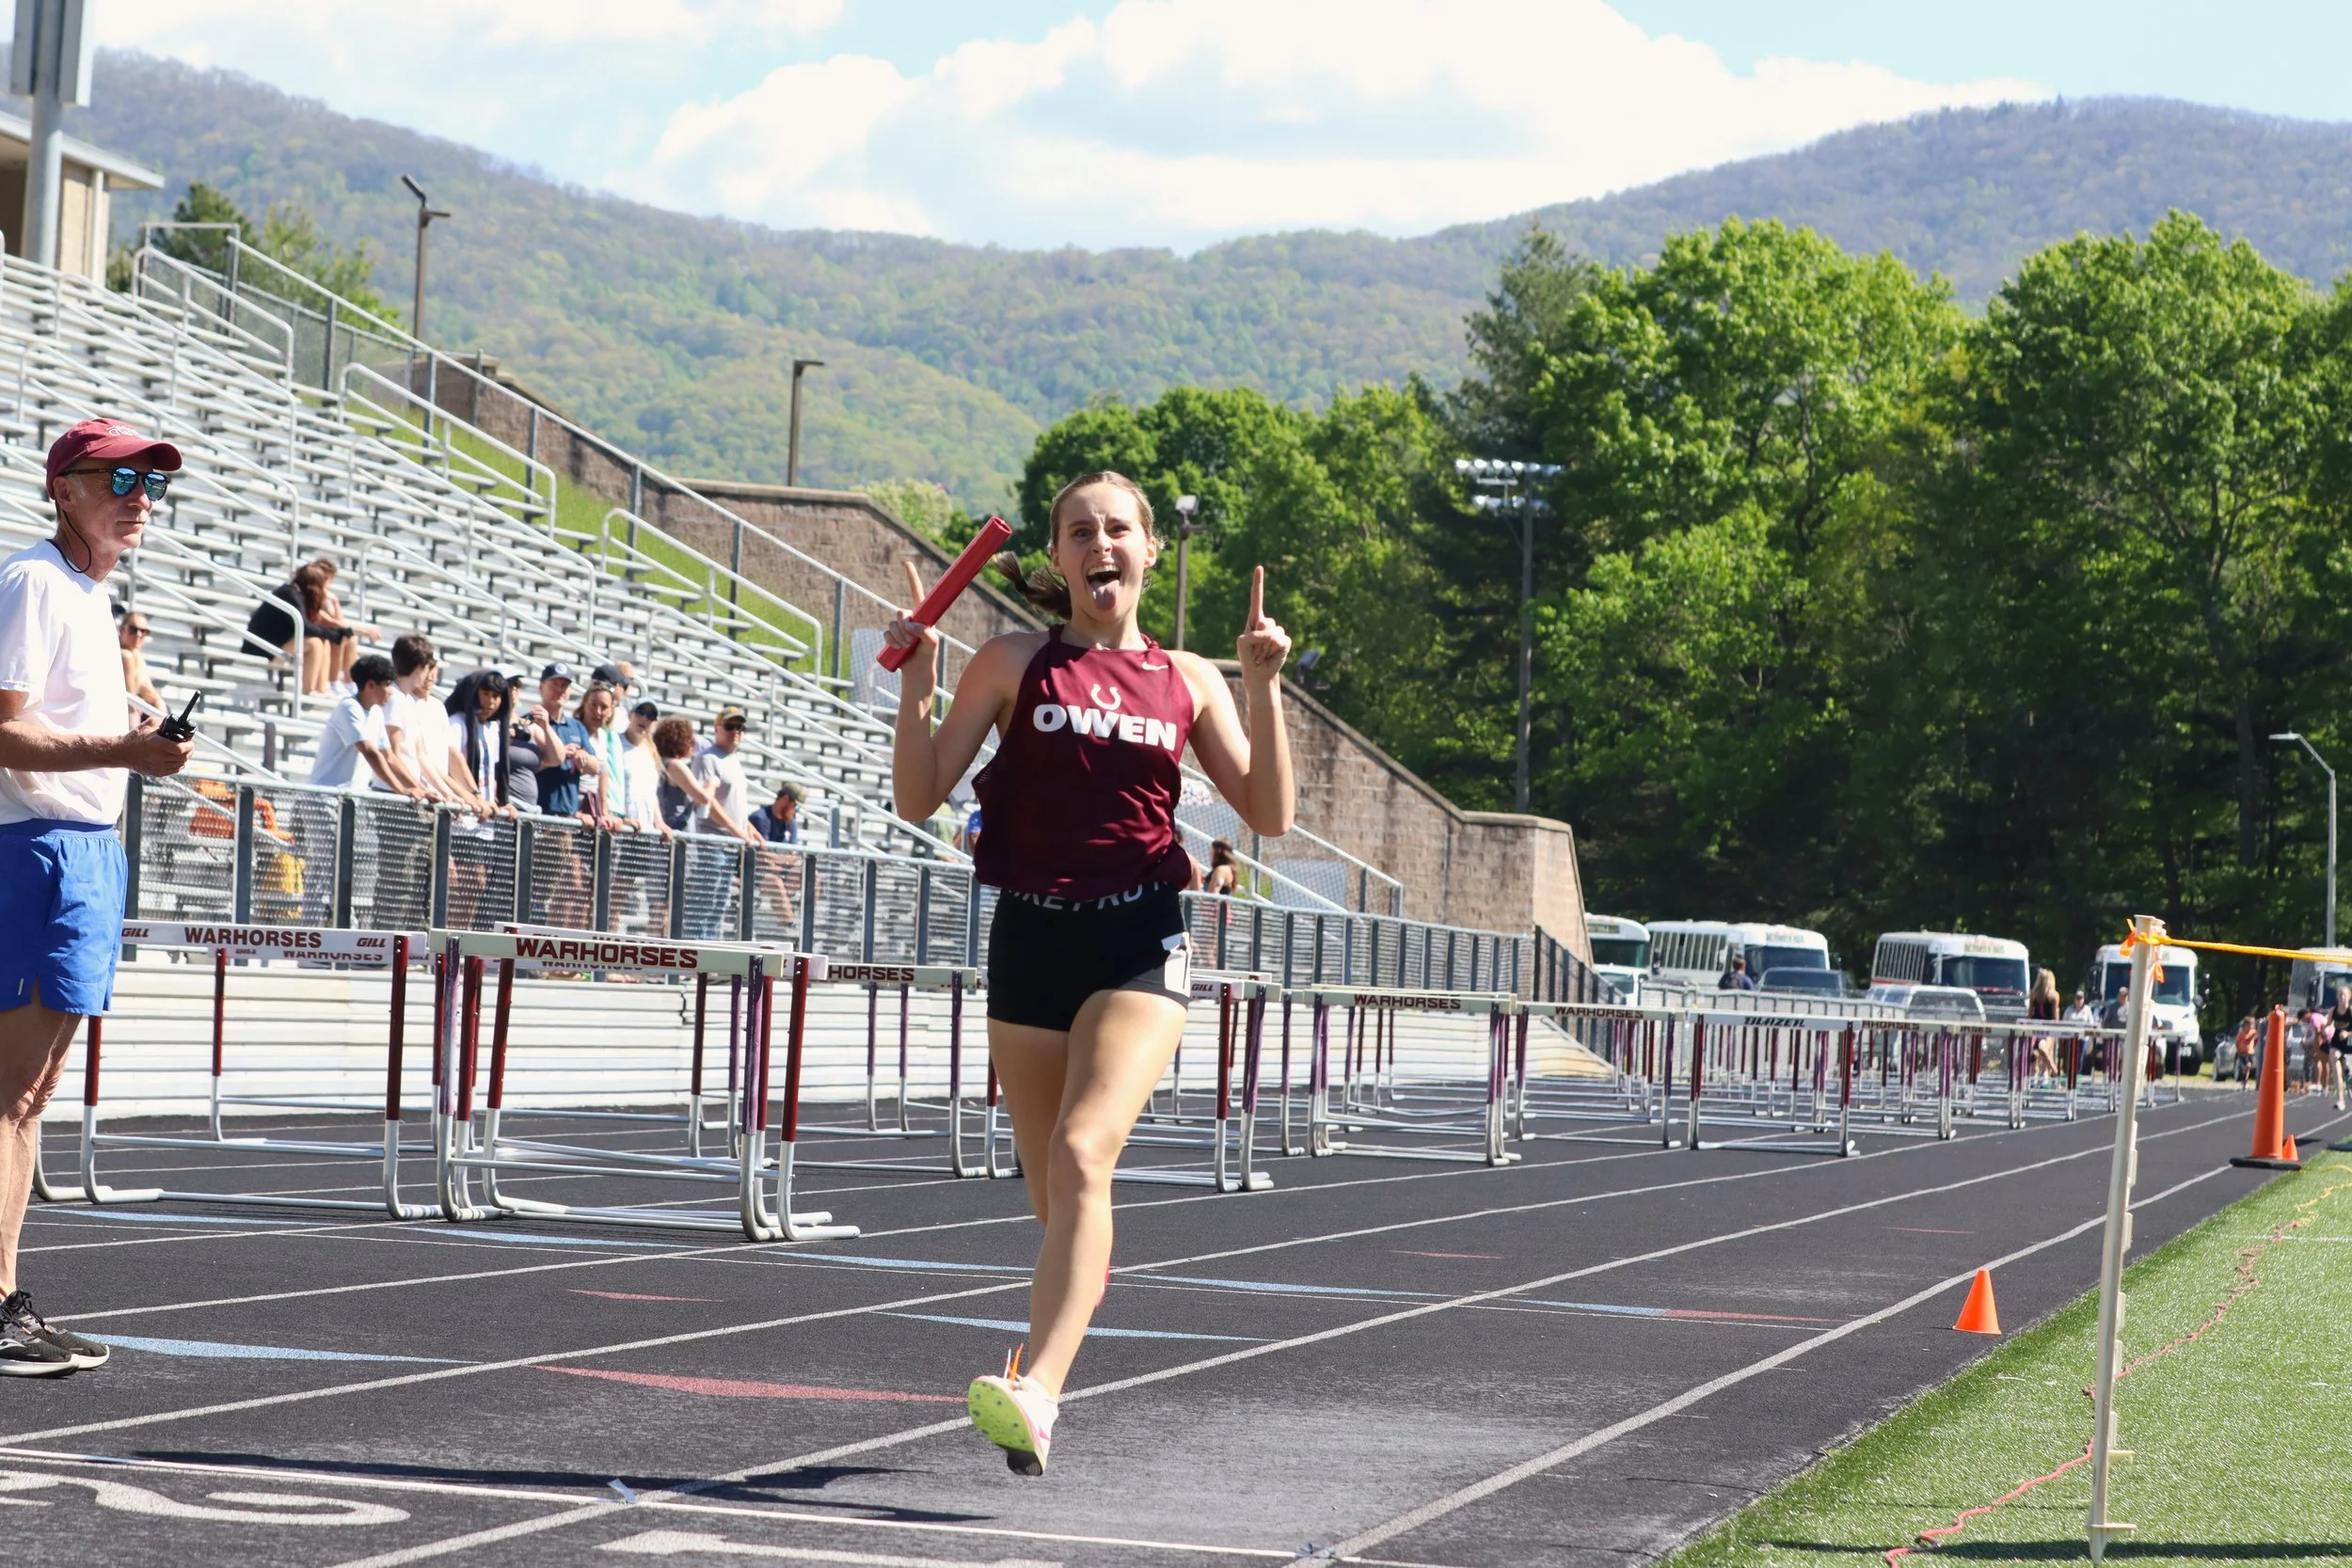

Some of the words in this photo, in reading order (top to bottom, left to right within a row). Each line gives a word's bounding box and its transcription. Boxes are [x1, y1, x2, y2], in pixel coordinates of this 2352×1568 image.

[1033, 704, 1177, 752] OWEN
[121, 927, 150, 938] GILL
[184, 927, 322, 948] WARHORSES
[357, 937, 387, 948] GILL
[516, 937, 698, 968] WARHORSES
[829, 965, 914, 981] HORSES
[1191, 983, 1214, 991] GILL
[1354, 993, 1461, 1009] WARHORSES
[1555, 1006, 1644, 1019] WARHORSES
[1744, 1016, 1805, 1027] BLAZER
